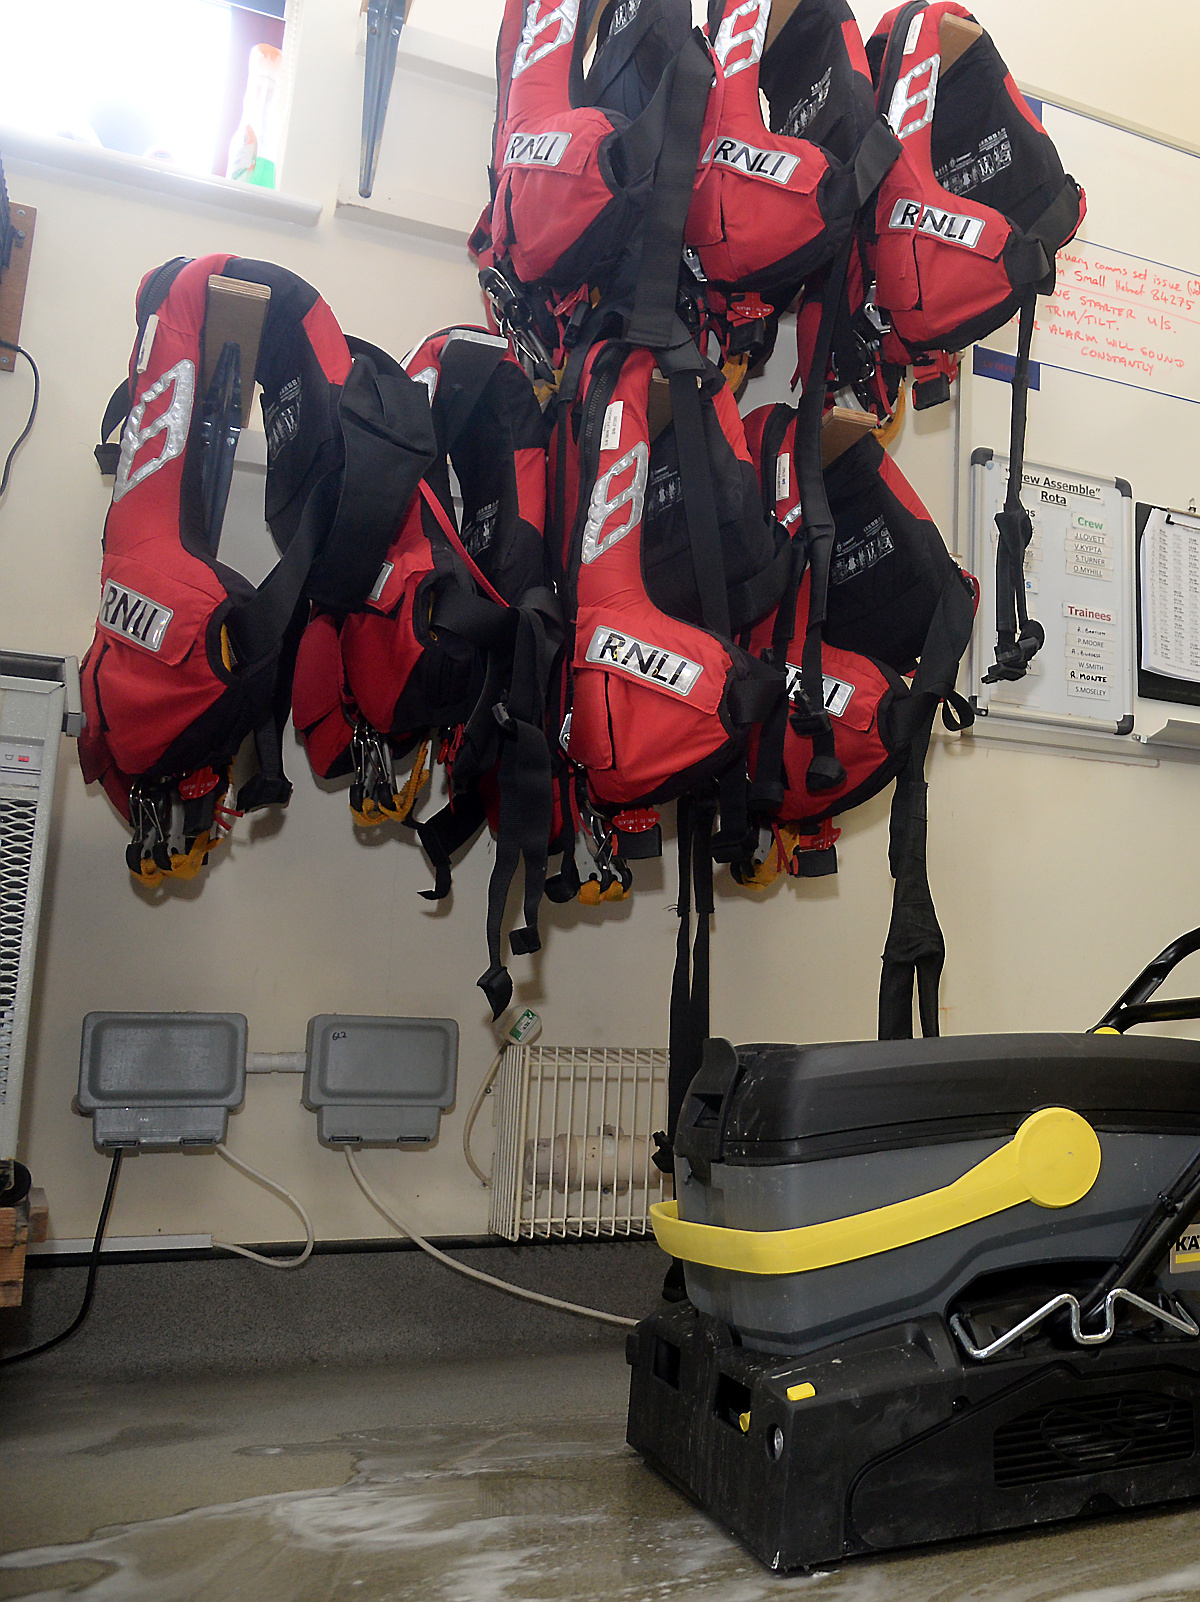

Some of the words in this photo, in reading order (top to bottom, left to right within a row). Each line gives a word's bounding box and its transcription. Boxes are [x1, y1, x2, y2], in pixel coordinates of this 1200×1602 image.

[510, 135, 559, 161] RNLI
[714, 140, 786, 176] RNLI
[901, 203, 971, 240] RNLI
[1074, 270, 1106, 287] Small
[1151, 289, 1195, 311] 84275
[1080, 296, 1136, 319] STARTER
[1106, 337, 1134, 351] WILL
[1081, 346, 1154, 375] CONSTANTLY
[1041, 490, 1067, 505] Rota
[1077, 516, 1103, 530] Crew
[100, 586, 158, 642] RNLI
[1067, 605, 1112, 622] Trainees
[600, 633, 687, 686] RNLI
[1078, 662, 1104, 671] W.SMITH
[1075, 686, 1107, 697] S.MOSELEY
